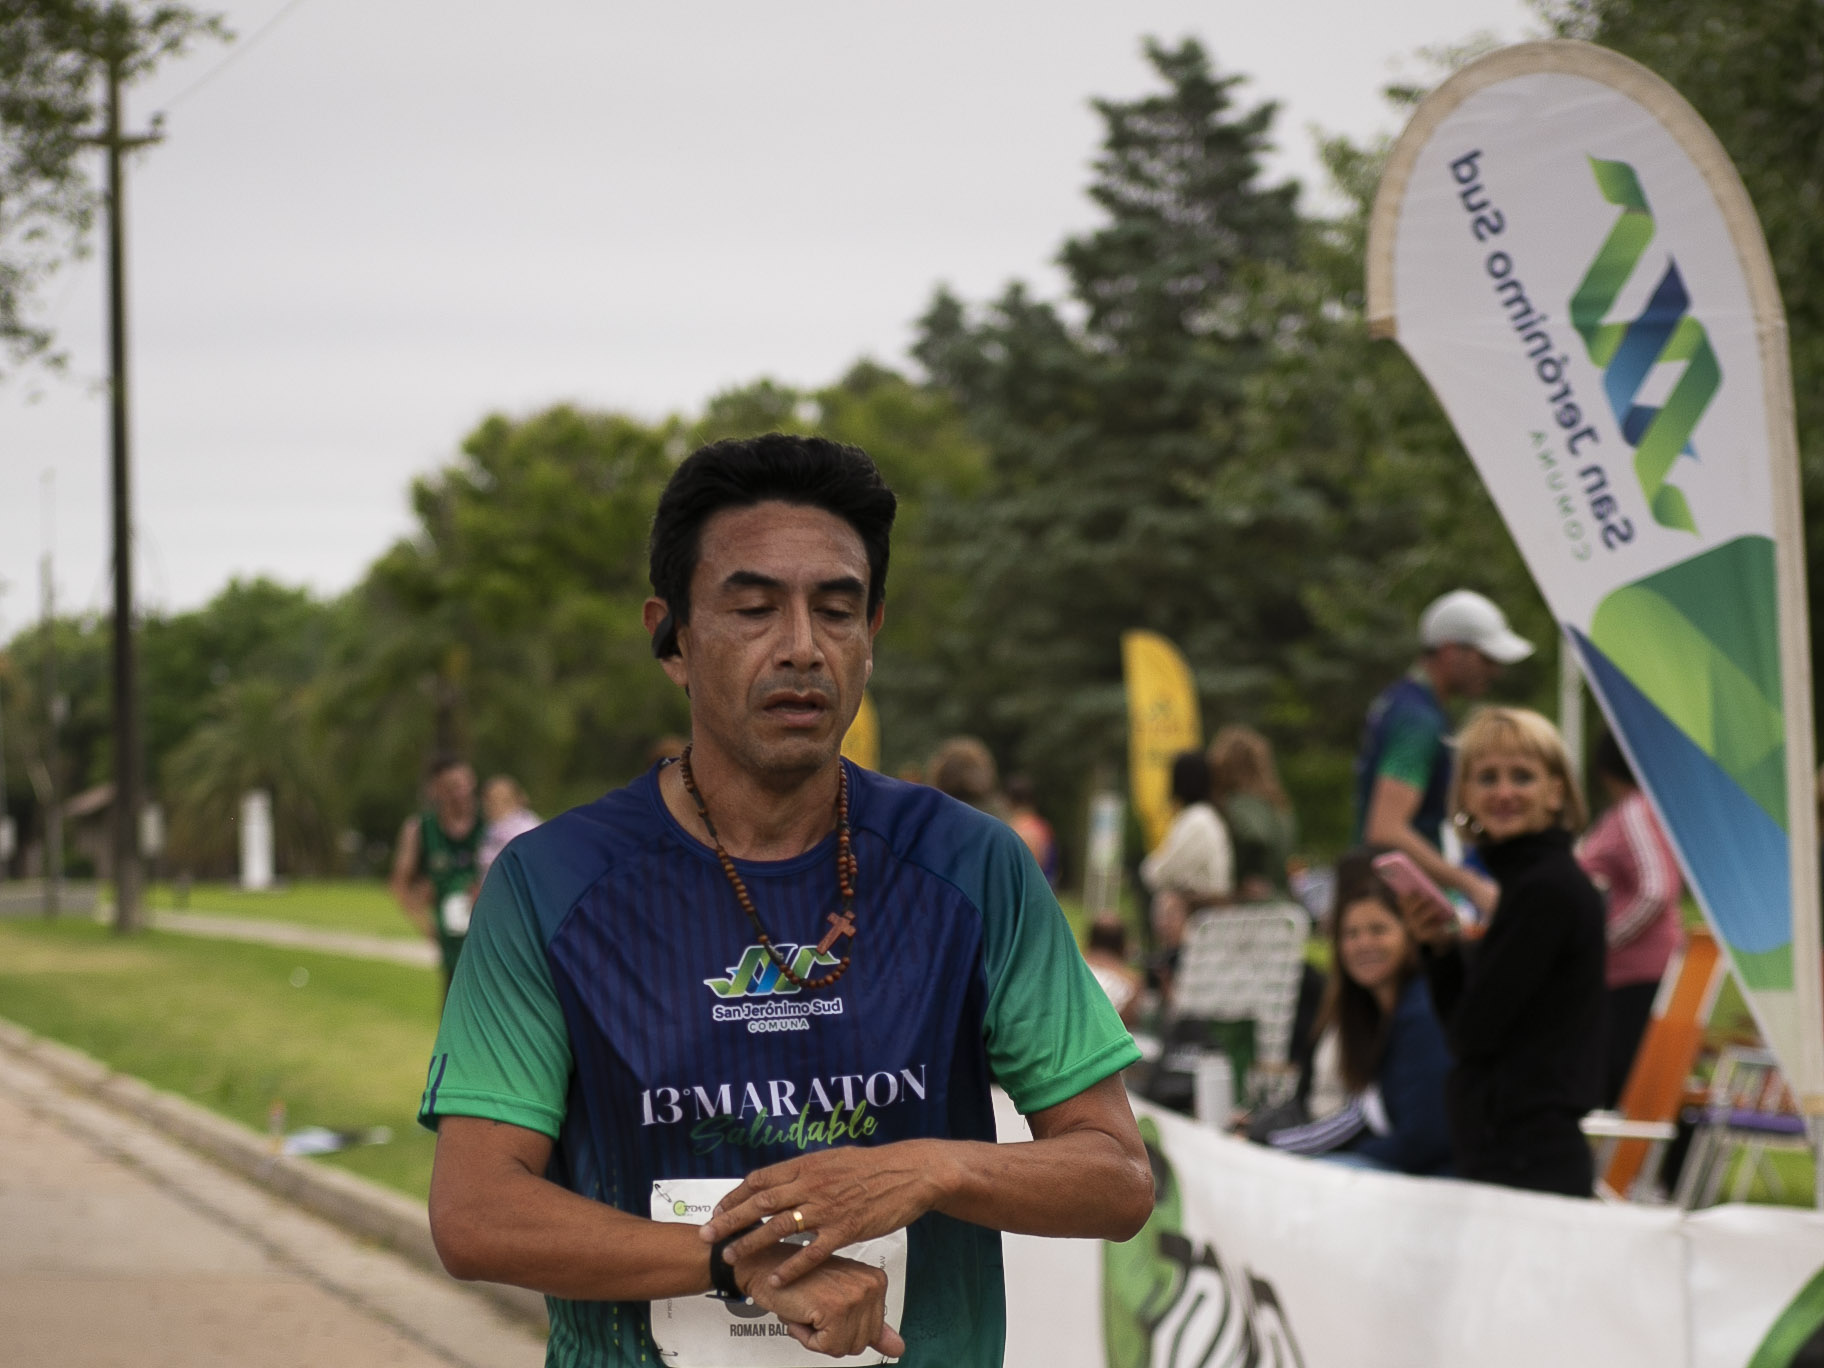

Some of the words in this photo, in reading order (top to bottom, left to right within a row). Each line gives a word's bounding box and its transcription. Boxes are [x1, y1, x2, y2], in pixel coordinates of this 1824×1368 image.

[713, 1005, 742, 1020] San
[742, 1000, 811, 1019] Jerónimo
[811, 998, 843, 1015] Sud
[748, 1018, 810, 1033] COMUNA
[692, 1064, 927, 1120] MARATON
[689, 1100, 879, 1156] Saludable
[730, 1323, 766, 1337] ROMAN
[768, 1323, 789, 1337] BAL
